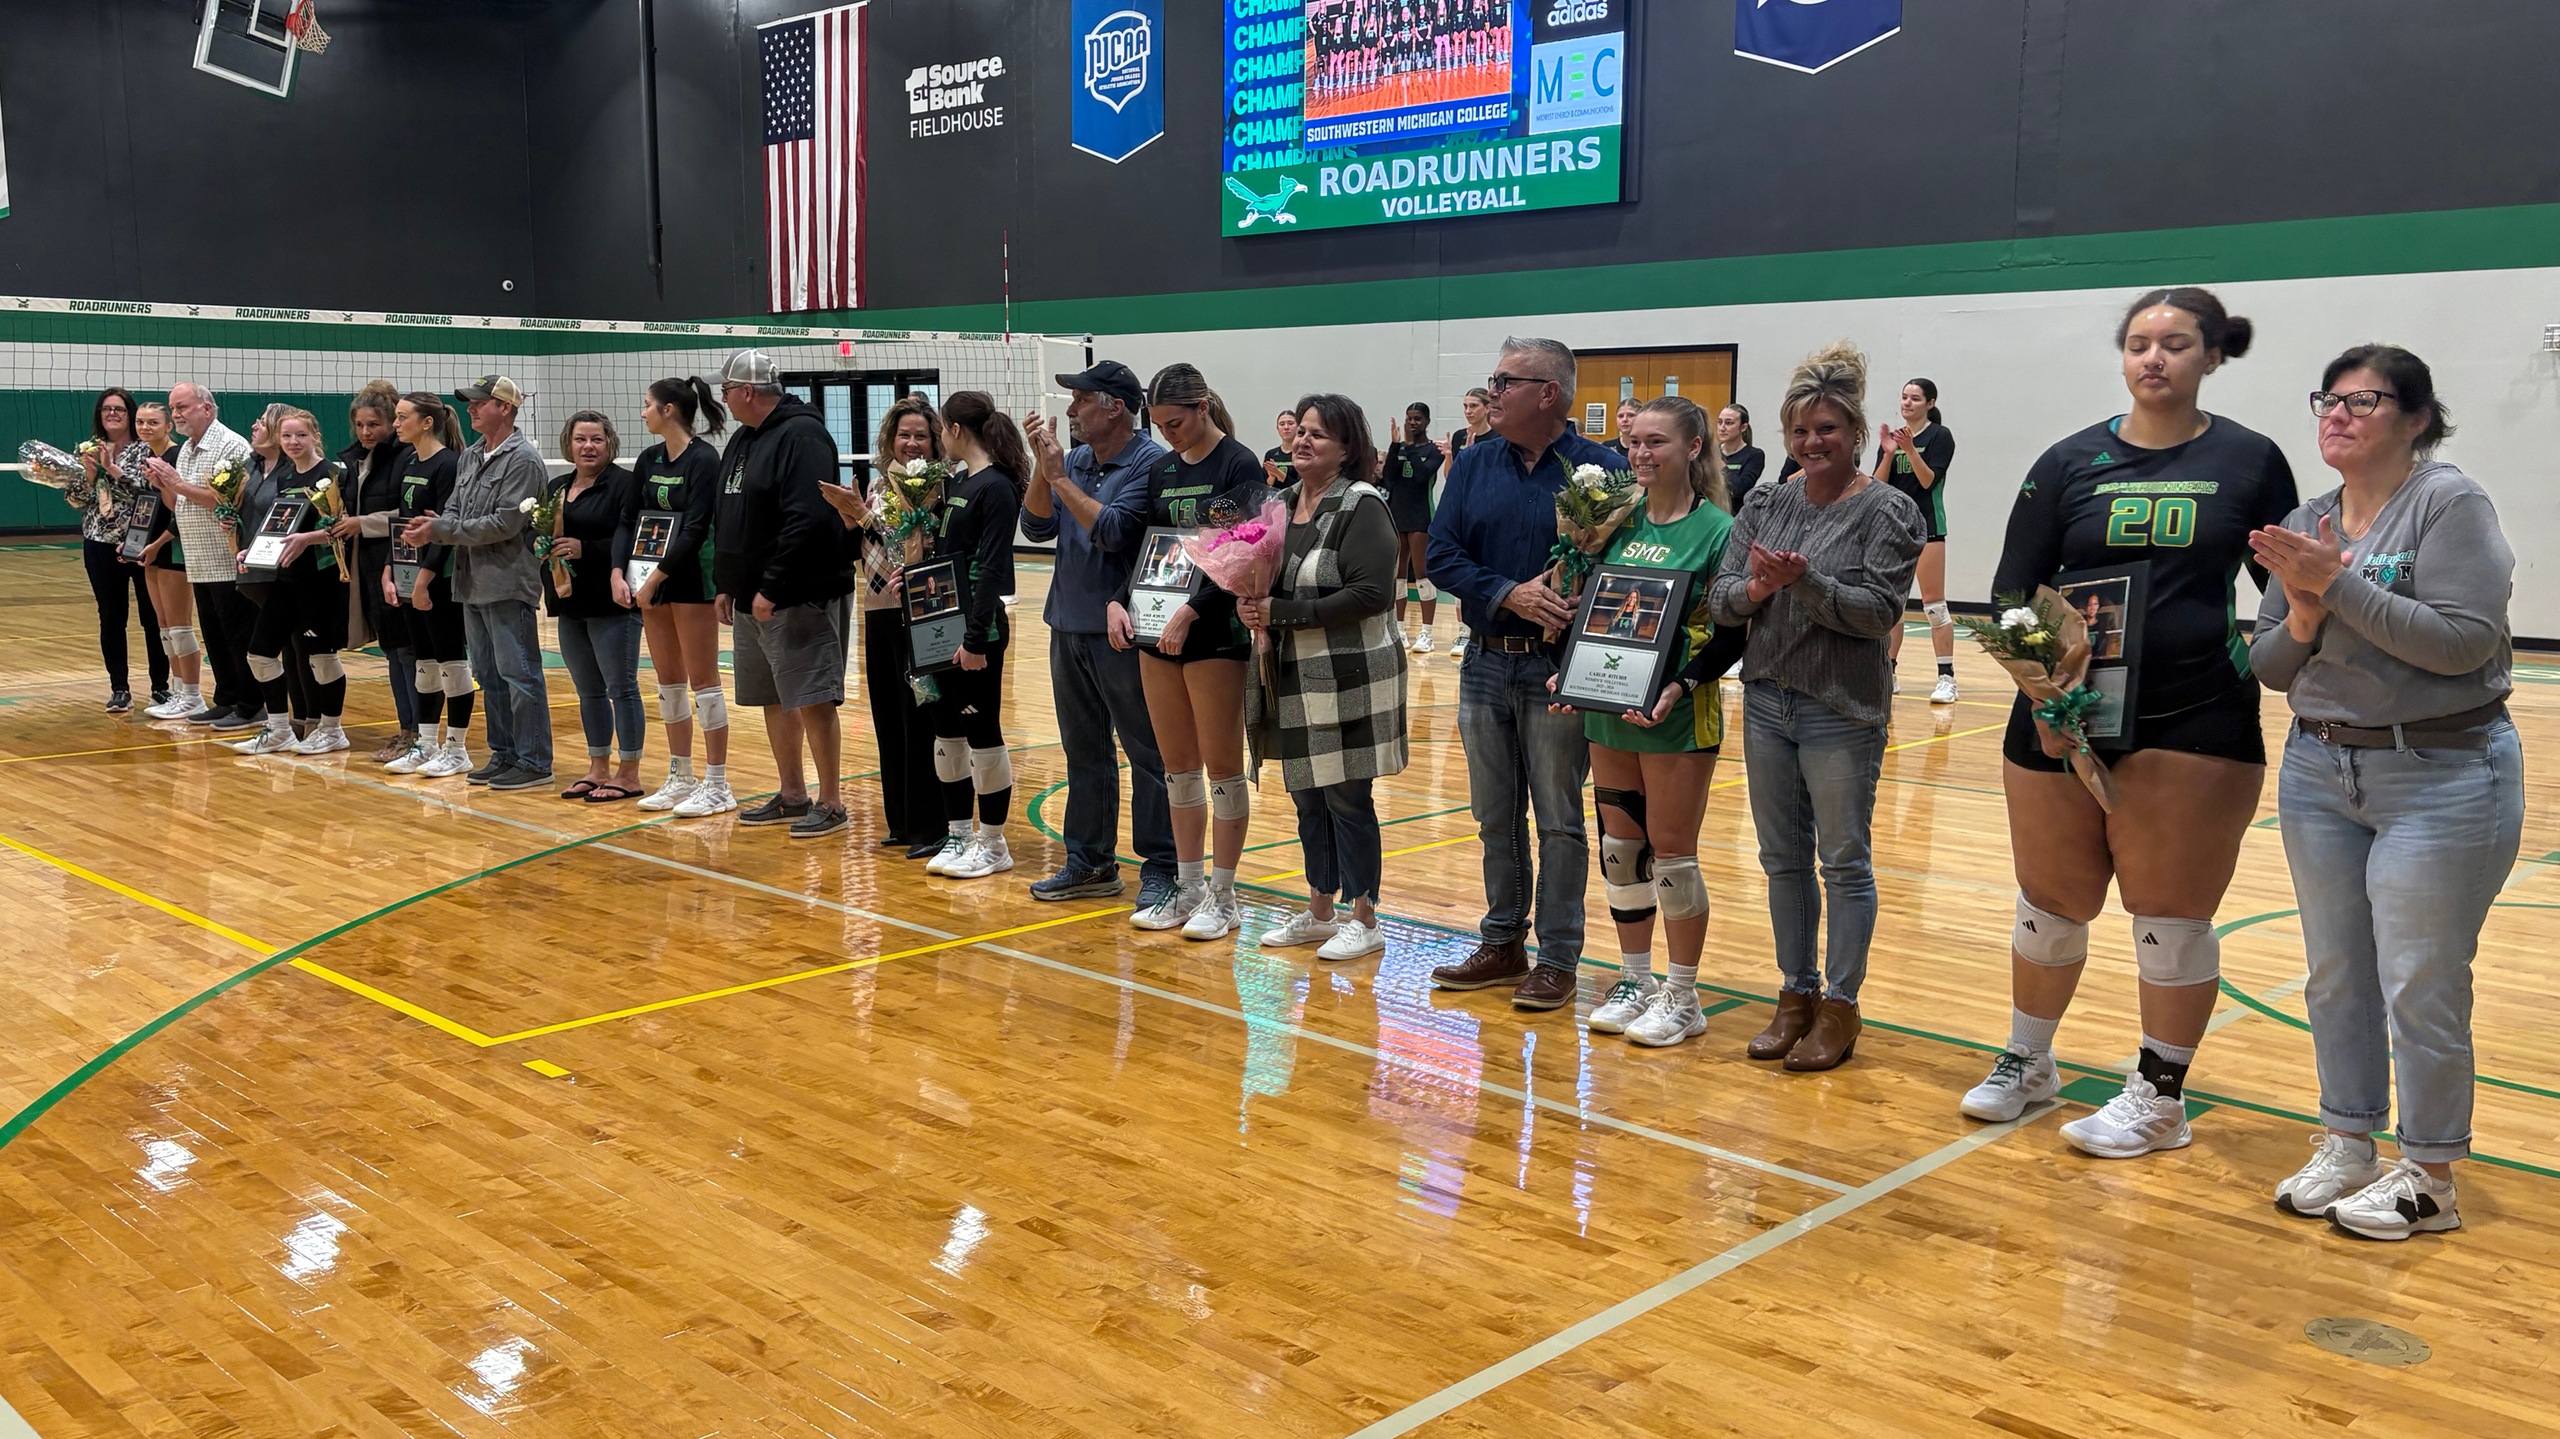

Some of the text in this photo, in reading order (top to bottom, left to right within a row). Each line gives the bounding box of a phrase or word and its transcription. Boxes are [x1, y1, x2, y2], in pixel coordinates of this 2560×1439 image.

[1547, 2, 1608, 26] adidas
[1087, 28, 1148, 83] NJCAA
[930, 81, 985, 111] Bank
[910, 106, 1003, 139] FIELDHOUSE
[1307, 102, 1508, 142] SOUTHWESTERN MICHIGAN COLLEGE
[1320, 136, 1601, 197] ROADRUNNERS
[1382, 185, 1526, 218] VOLLEYBALL
[69, 300, 1003, 341] ROADRUNNERS ROADRUNNERS ROADRUNNERS ROADRUNNERS ROADRUNNERS ROADRUNNERS ROADRUNNERS ROADRUNNERS
[1168, 498, 1199, 527] 13
[2106, 497, 2197, 548] 20
[1621, 541, 1672, 564] SMC
